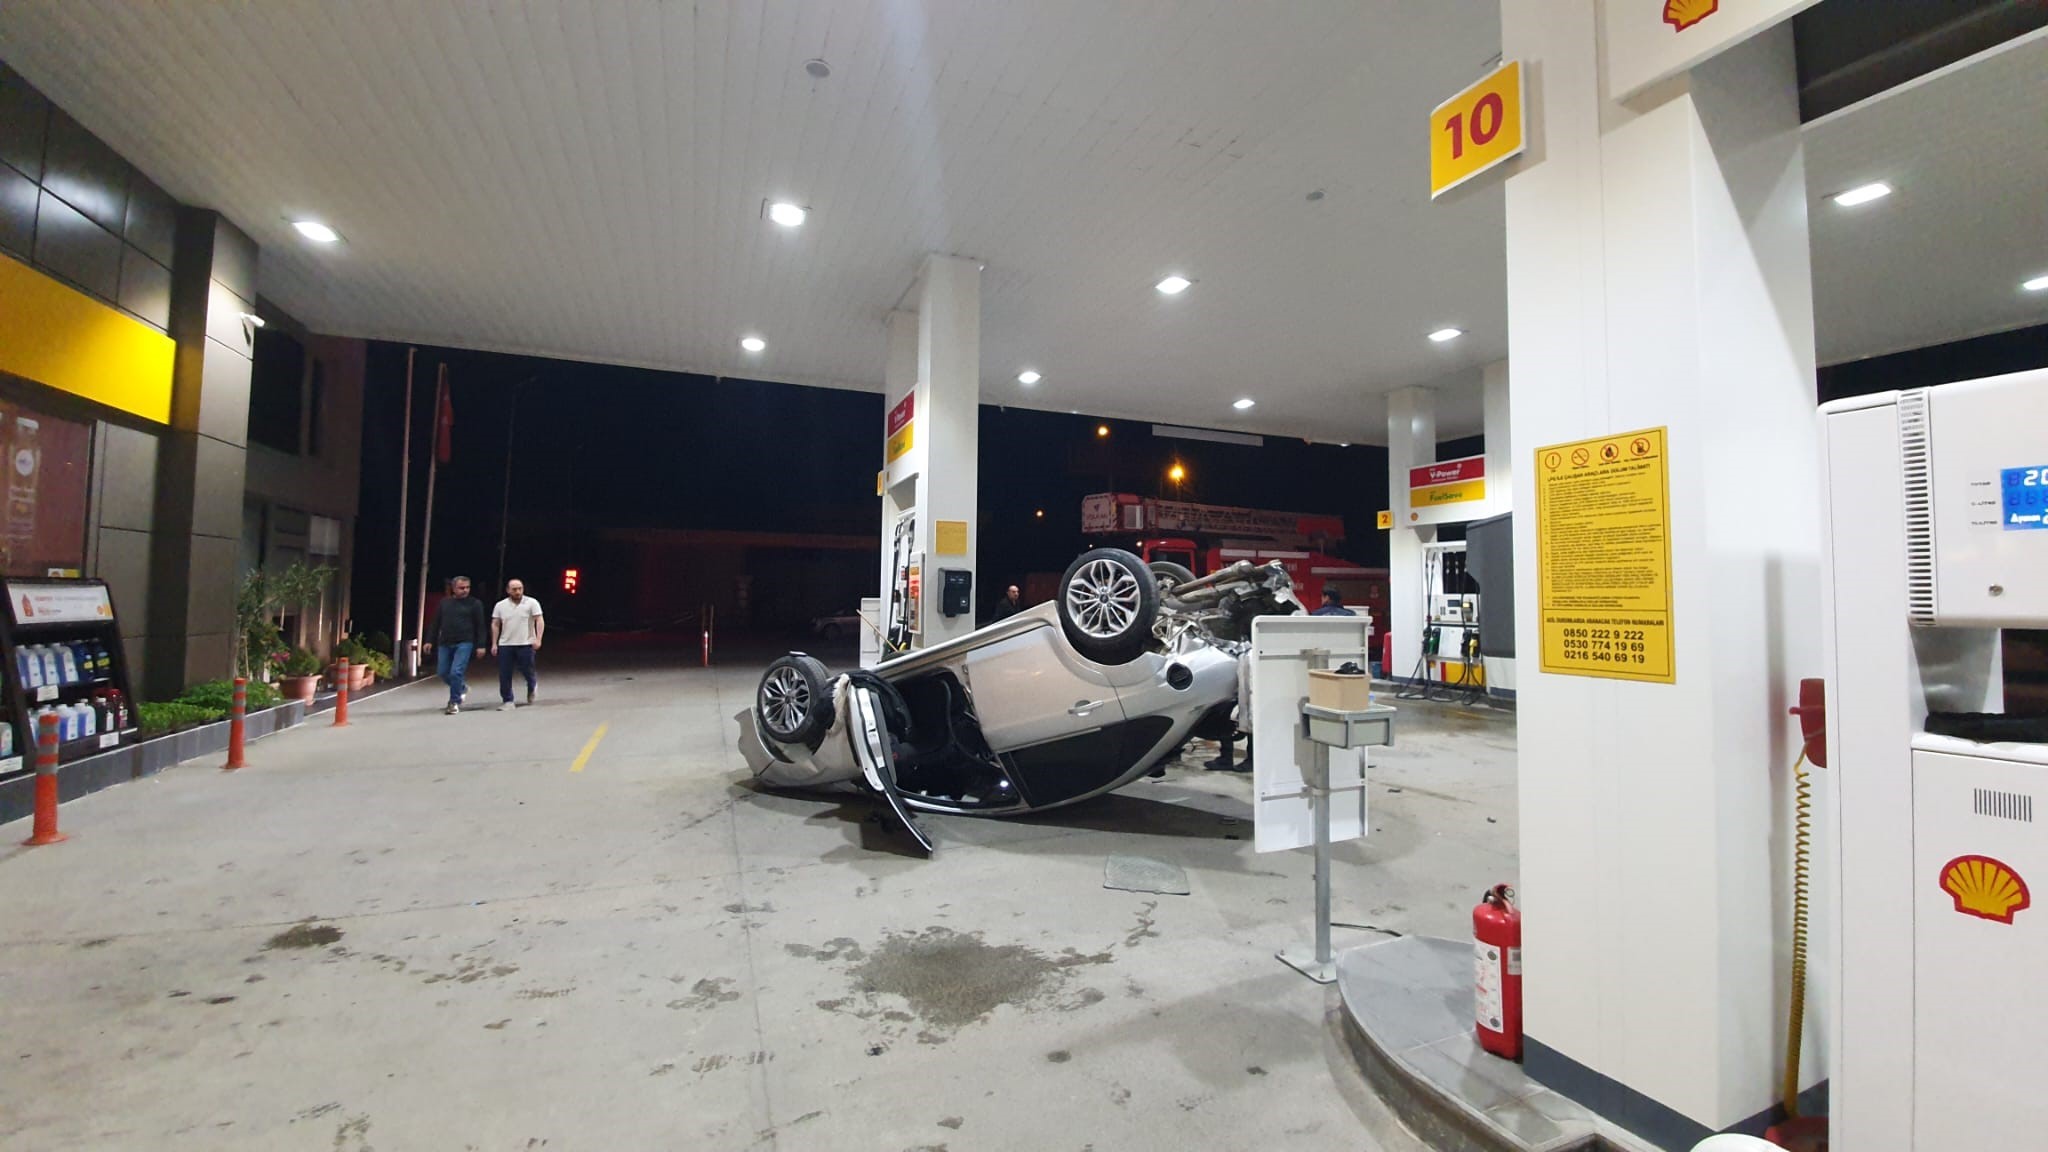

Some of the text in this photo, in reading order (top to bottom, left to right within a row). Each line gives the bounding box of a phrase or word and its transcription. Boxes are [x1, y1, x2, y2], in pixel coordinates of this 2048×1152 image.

[1444, 92, 1503, 160] 10
[1382, 514, 1389, 524] 2
[1563, 628, 1644, 641] 0850 222 9 222
[1563, 639, 1645, 652] 0530 774 19 69
[1564, 650, 1645, 664] 0216 540 69 19
